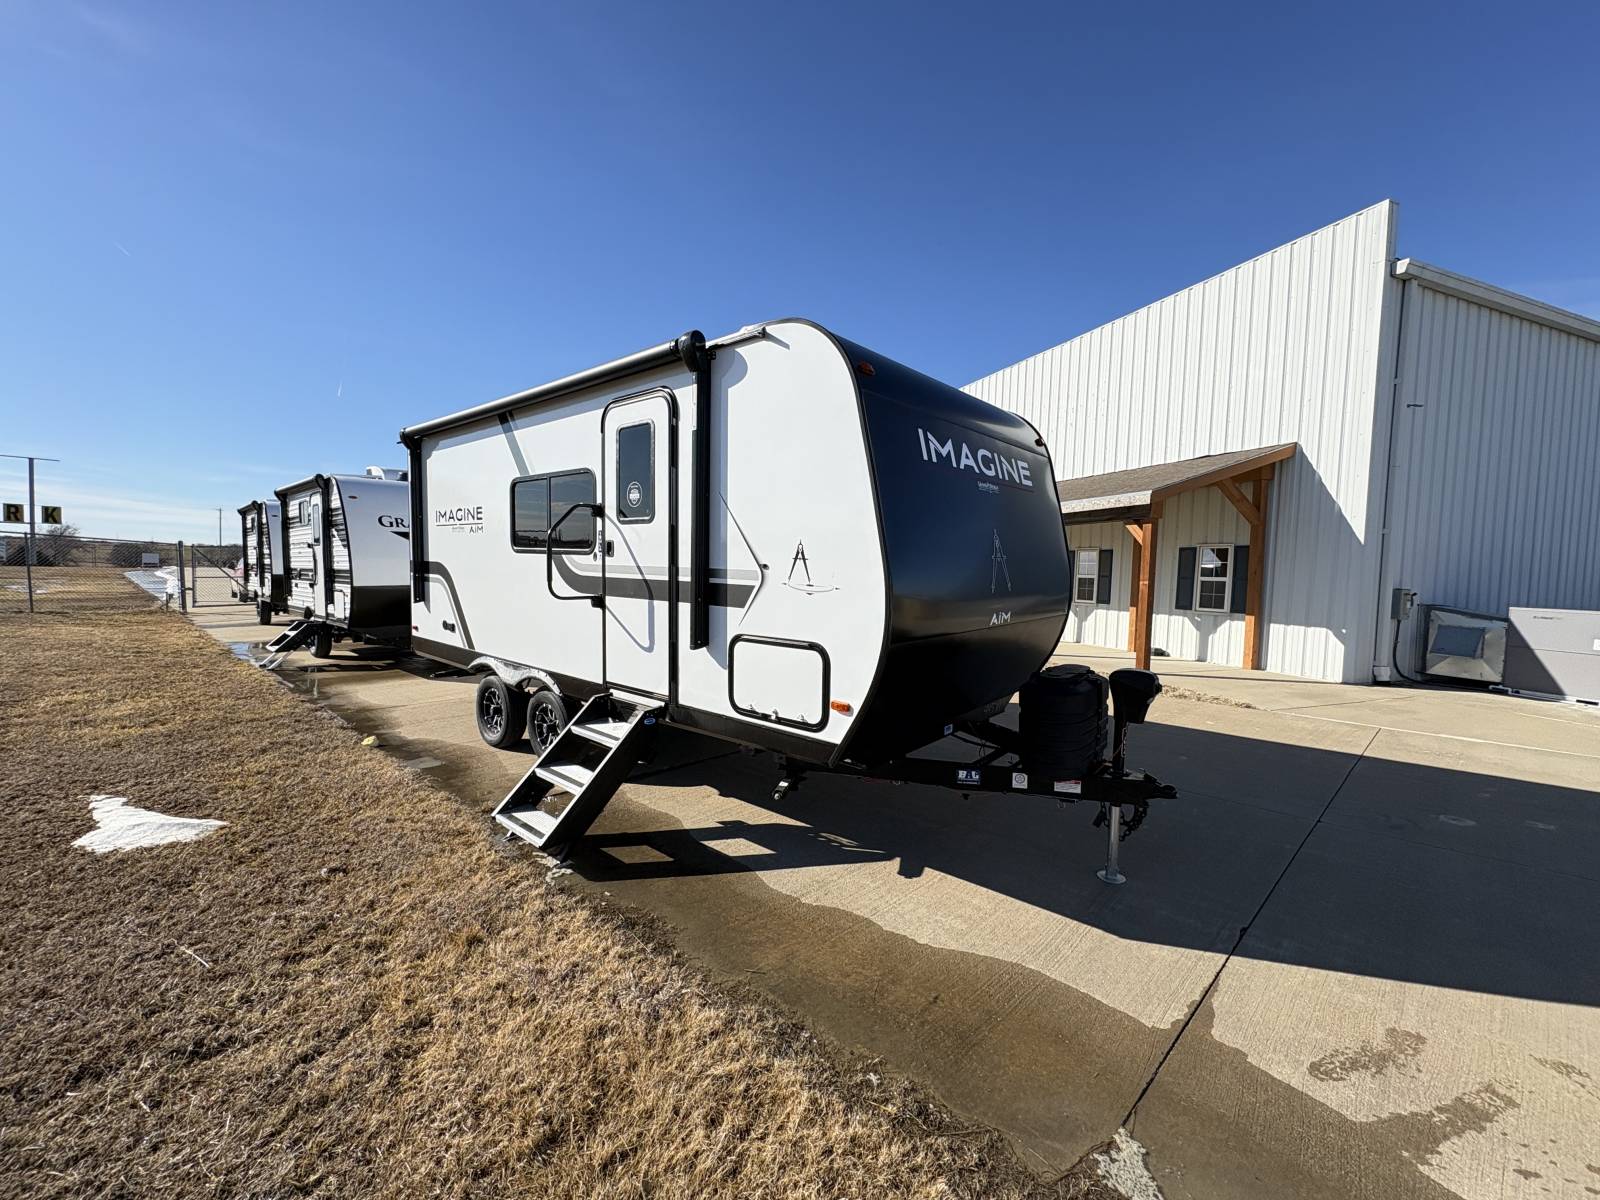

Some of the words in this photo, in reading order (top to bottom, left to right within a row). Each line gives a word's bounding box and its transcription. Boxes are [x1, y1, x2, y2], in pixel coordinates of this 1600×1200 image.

[918, 428, 1033, 487] IMAGINE
[6, 504, 20, 521] R
[44, 506, 58, 523] K
[377, 514, 410, 528] GR
[435, 506, 483, 523] IMAGINE
